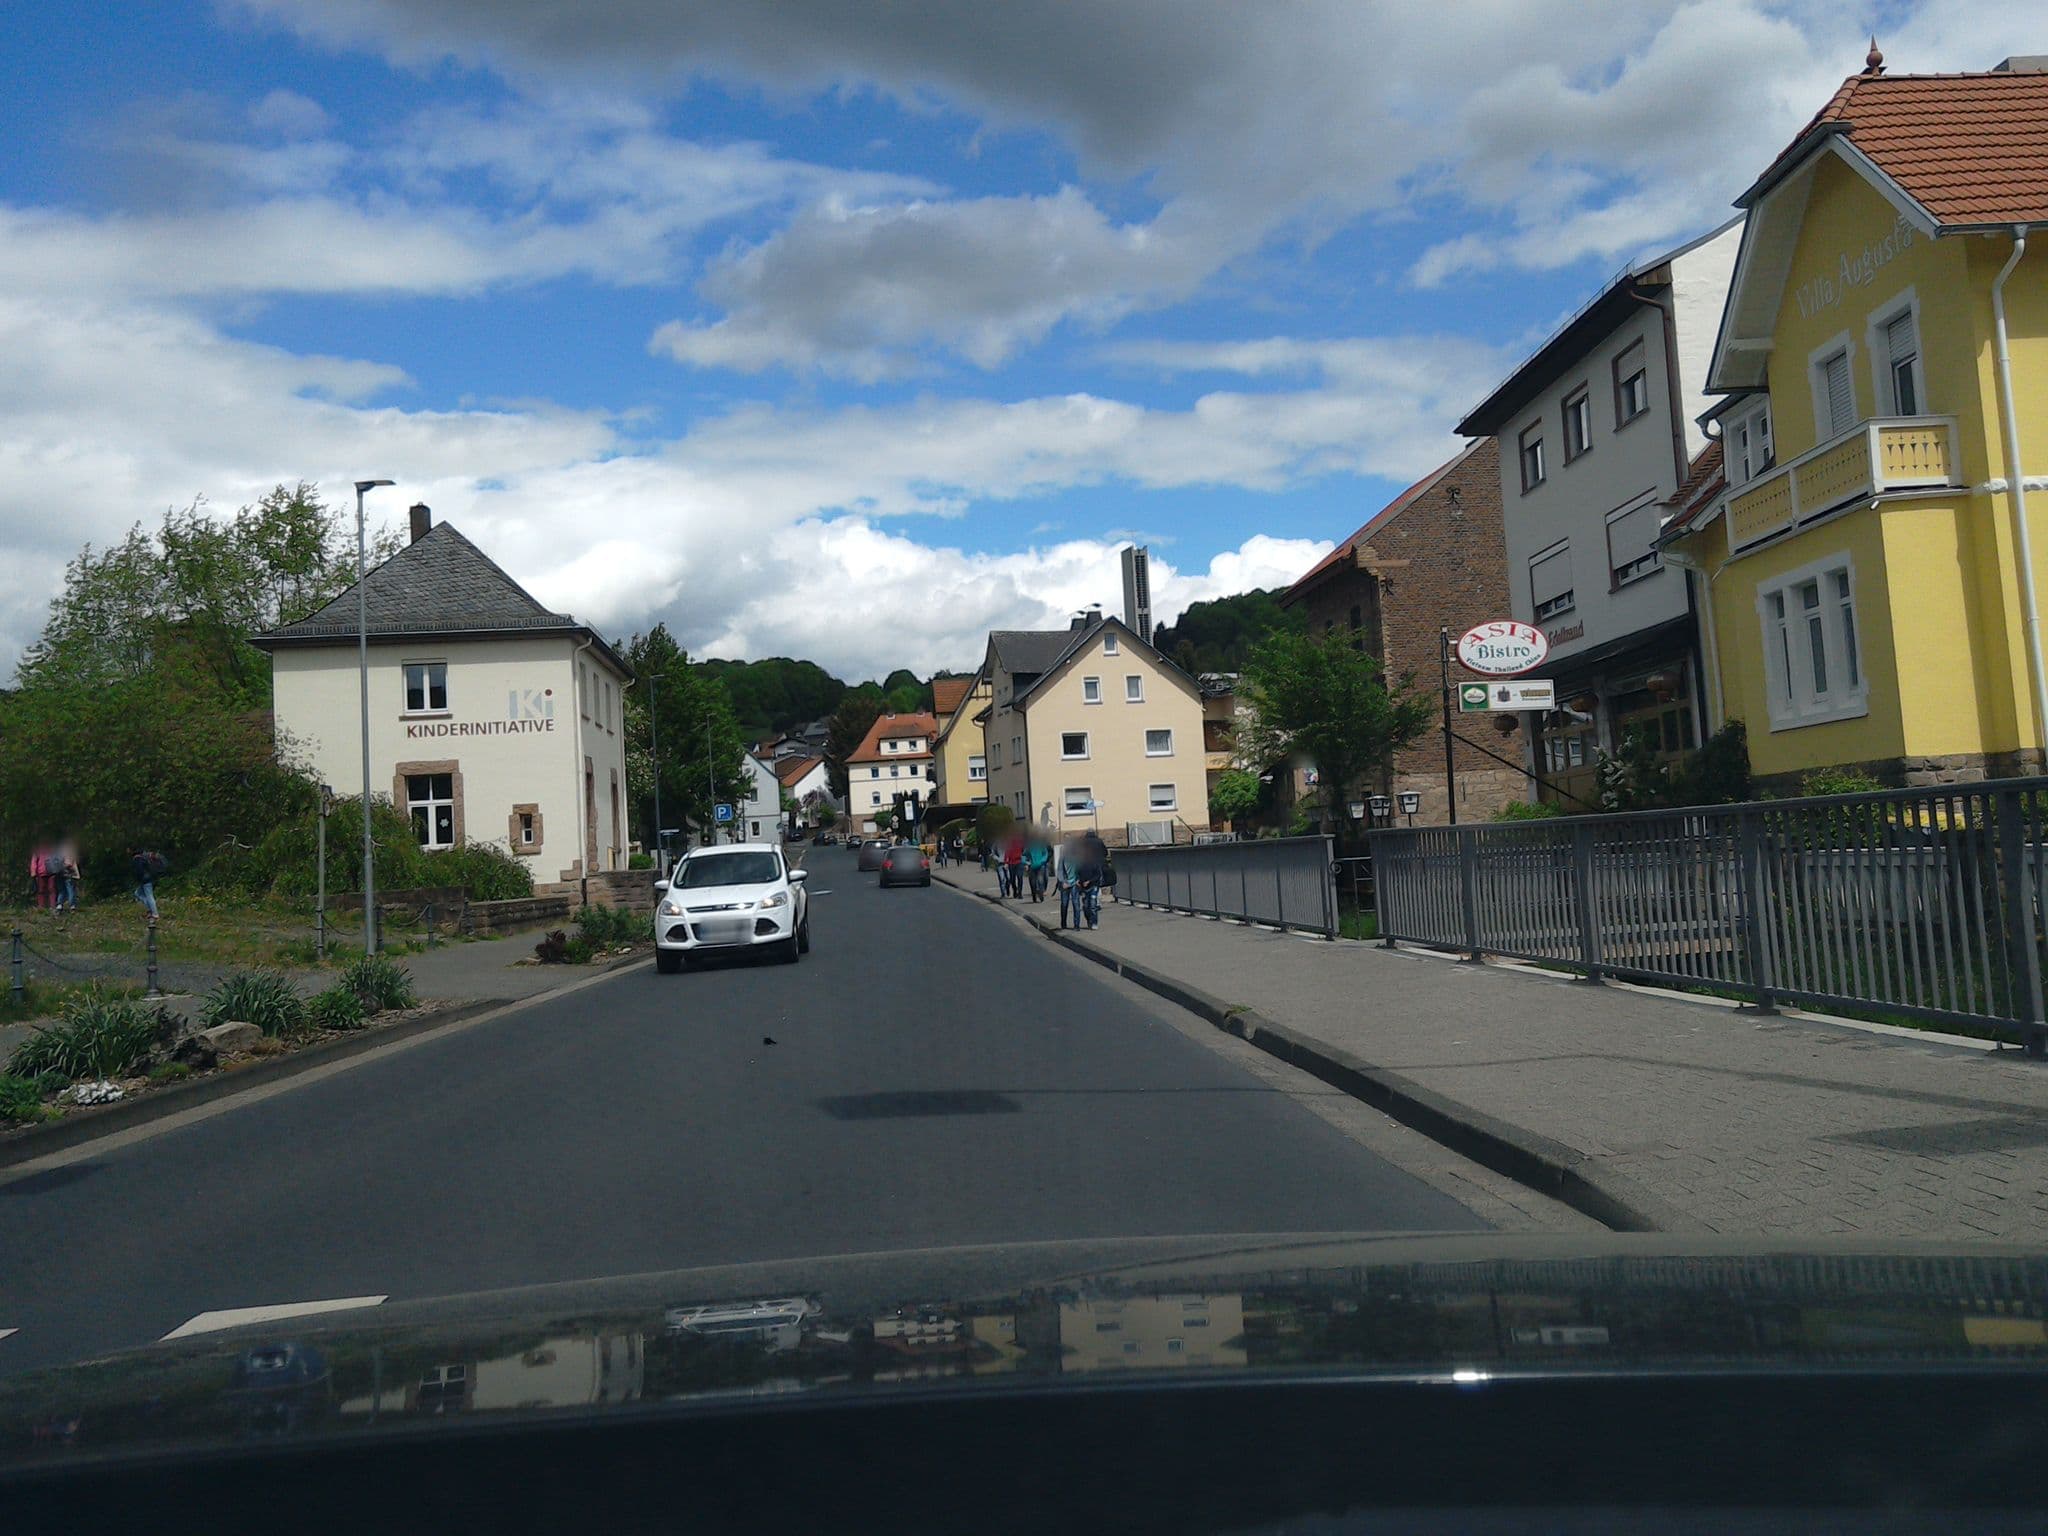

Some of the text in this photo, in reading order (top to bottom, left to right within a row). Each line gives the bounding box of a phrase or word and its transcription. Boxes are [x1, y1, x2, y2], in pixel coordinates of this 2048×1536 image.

[1463, 623, 1538, 650] ASIA
[1478, 644, 1530, 659] Bistro
[1466, 653, 1542, 673] Vietnam Thailand China
[407, 718, 555, 738] KINDERINITIATIVE
[717, 806, 727, 819] P
